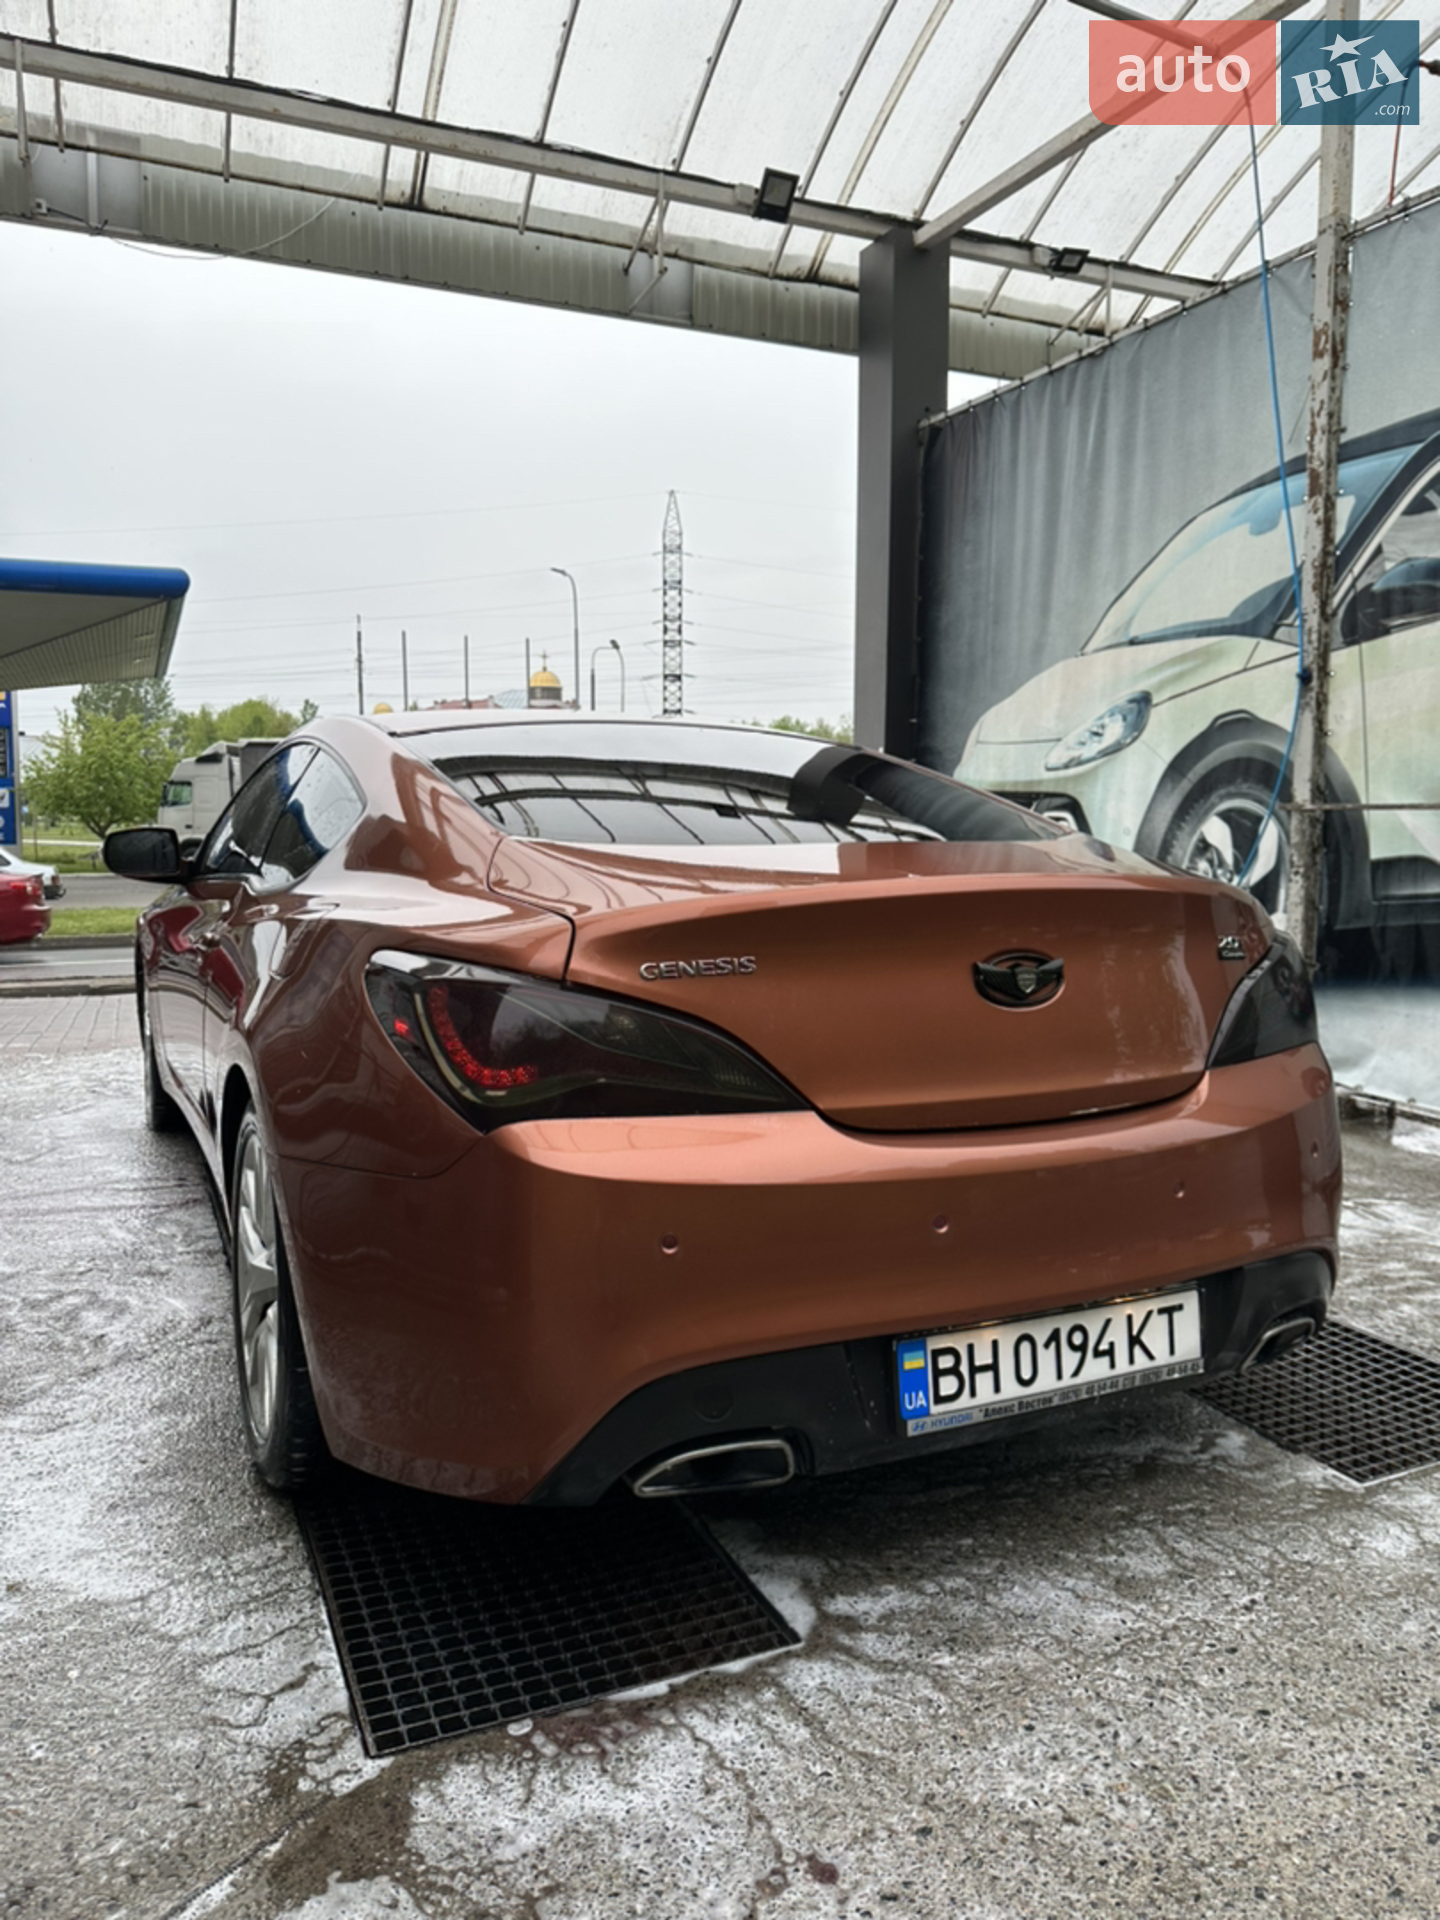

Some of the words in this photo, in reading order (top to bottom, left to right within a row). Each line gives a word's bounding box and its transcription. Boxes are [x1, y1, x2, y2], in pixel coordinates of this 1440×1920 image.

[639, 956, 757, 980] GENESIS
[904, 1390, 927, 1411] UA
[930, 1412, 973, 1429] HYUNDAI
